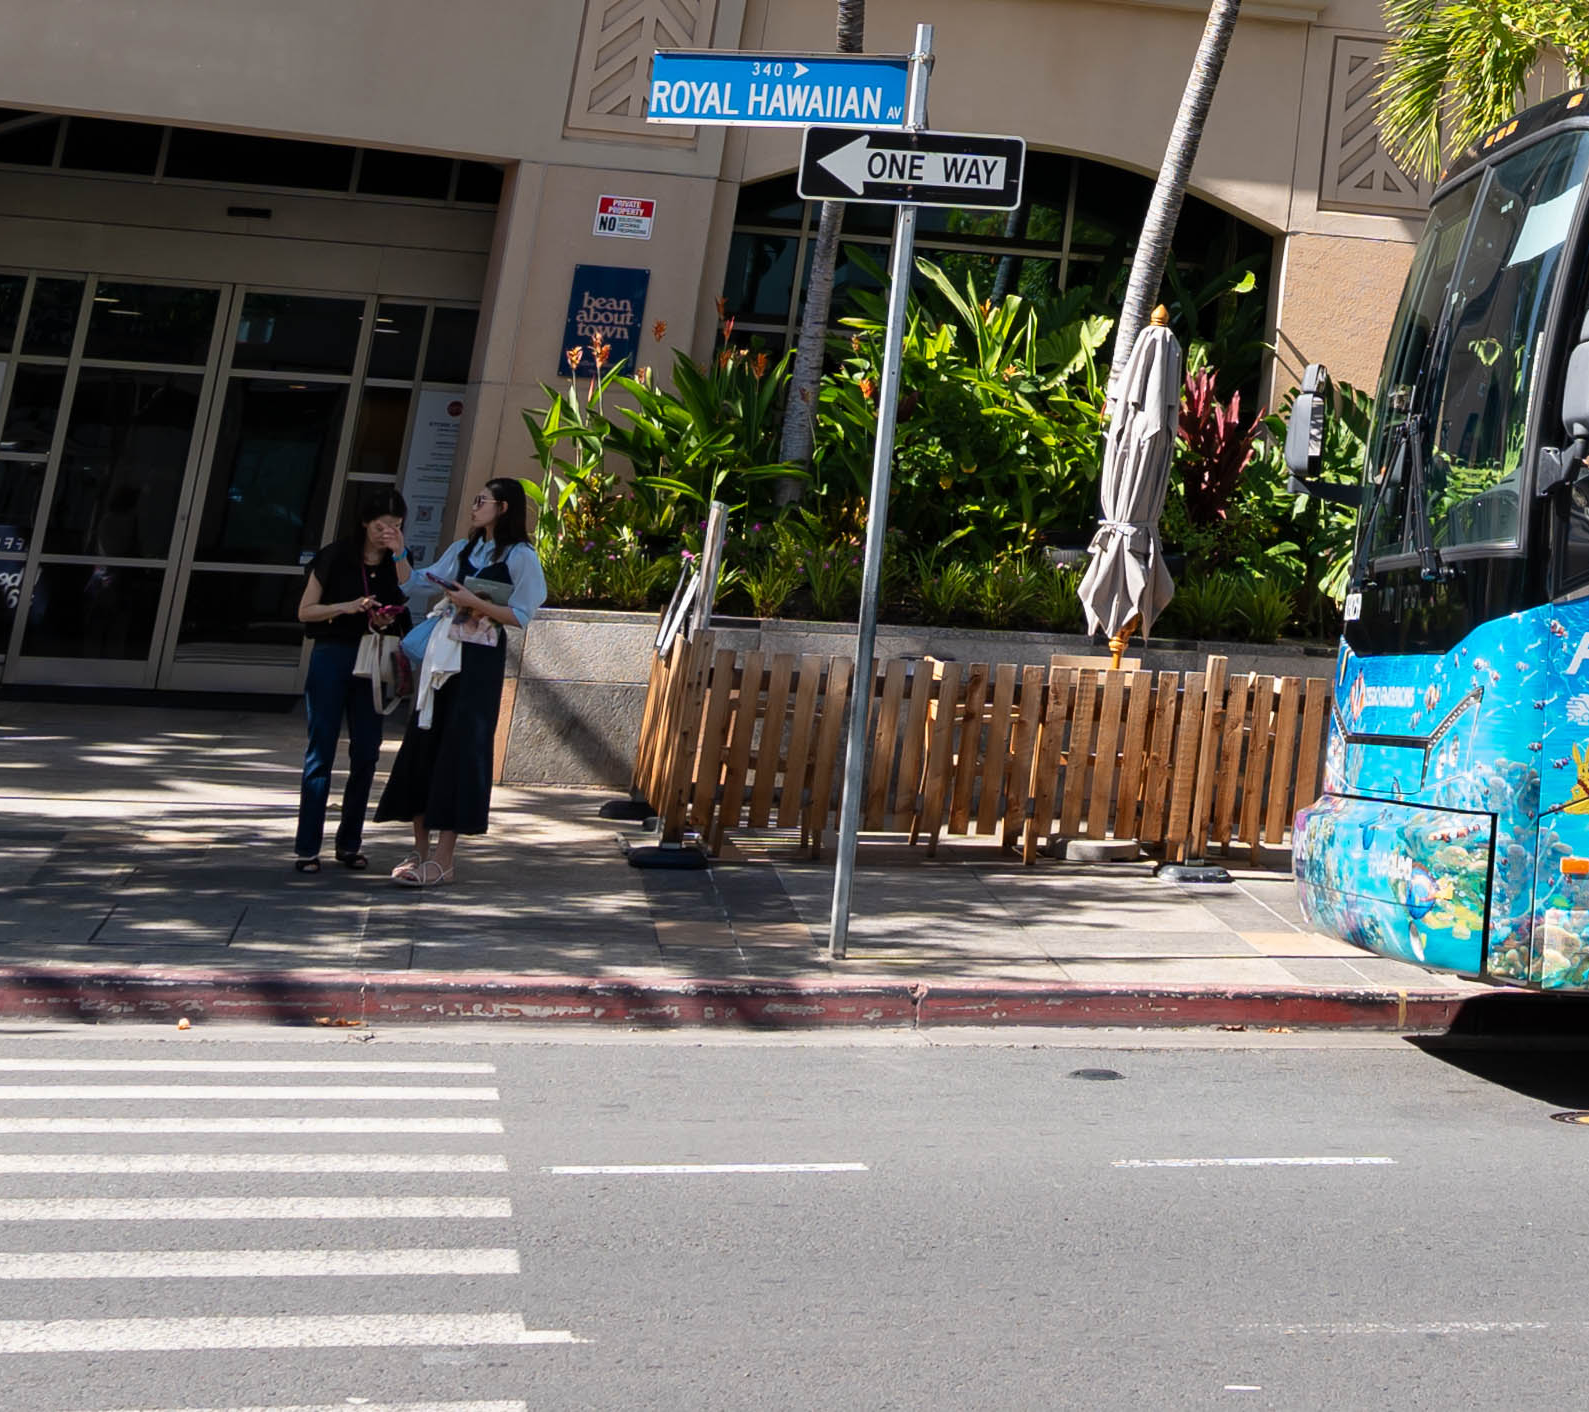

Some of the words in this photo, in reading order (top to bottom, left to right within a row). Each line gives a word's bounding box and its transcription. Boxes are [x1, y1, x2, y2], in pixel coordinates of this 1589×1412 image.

[751, 61, 783, 78] 340
[650, 80, 739, 116] ROYAL
[747, 83, 883, 120] HAWAIIAN
[886, 105, 902, 120] AV
[867, 151, 925, 181] ONE
[943, 156, 998, 185] WAY
[607, 206, 645, 217] PROPERTY
[598, 215, 617, 232] NO
[582, 290, 632, 312] bean
[575, 307, 635, 326] about
[576, 322, 629, 340] town
